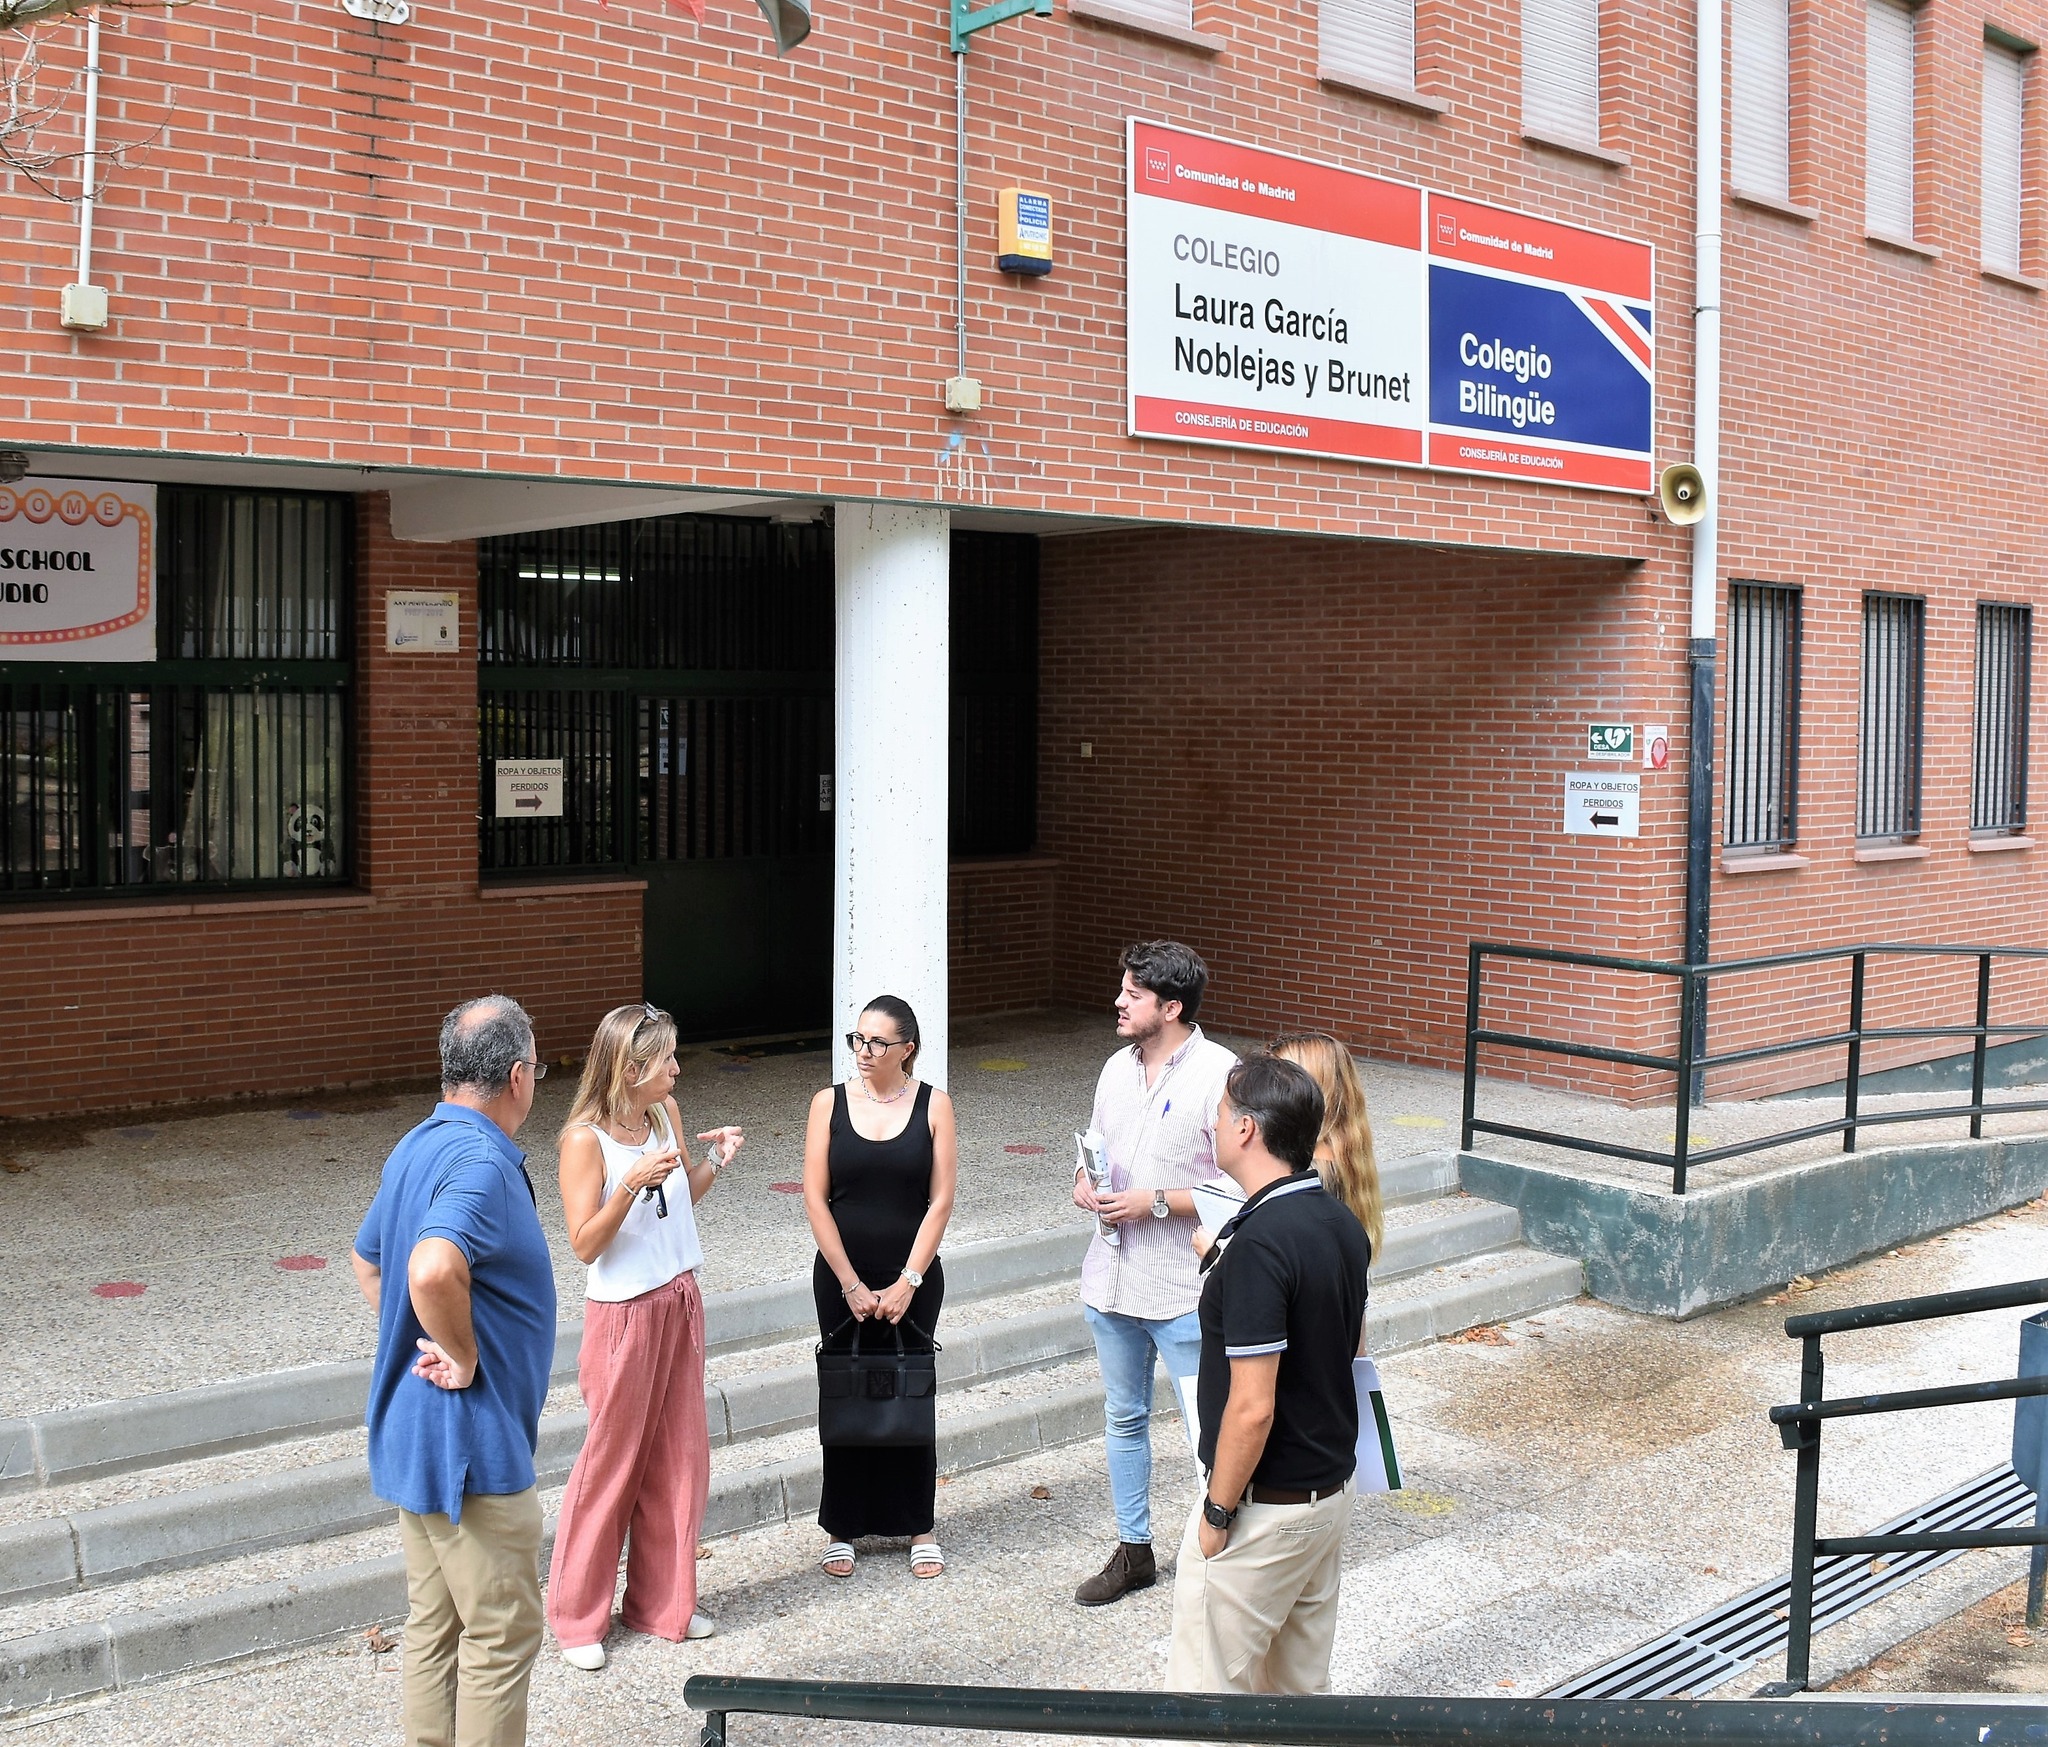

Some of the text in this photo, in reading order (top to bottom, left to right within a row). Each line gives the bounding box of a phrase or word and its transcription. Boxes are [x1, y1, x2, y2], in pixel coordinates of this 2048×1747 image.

[1175, 164, 1296, 201] Comunidad de Madrid
[1019, 197, 1047, 207] ALARMA
[1173, 234, 1280, 277] COLEGIO
[1459, 228, 1554, 260] Comunidad de Madrid
[1175, 283, 1348, 344] Laura García
[1175, 336, 1410, 402] Noblejas y Brunet
[1460, 332, 1552, 383] Colegio
[1460, 380, 1555, 428] Bilingüe
[1175, 411, 1309, 437] CONSEJERÍA DE EDUCACIÓN
[1459, 446, 1564, 469] CONSEJERÍA DE EDUCACIÓN
[0, 548, 95, 571] SCHOOL
[497, 767, 519, 775] ROPA
[527, 767, 561, 775] OBJETOS
[510, 782, 549, 791] PERDIDOS
[1569, 781, 1592, 790] ROPA
[1600, 782, 1638, 791] OBJETOS
[1583, 798, 1624, 808] PERDIDOS
